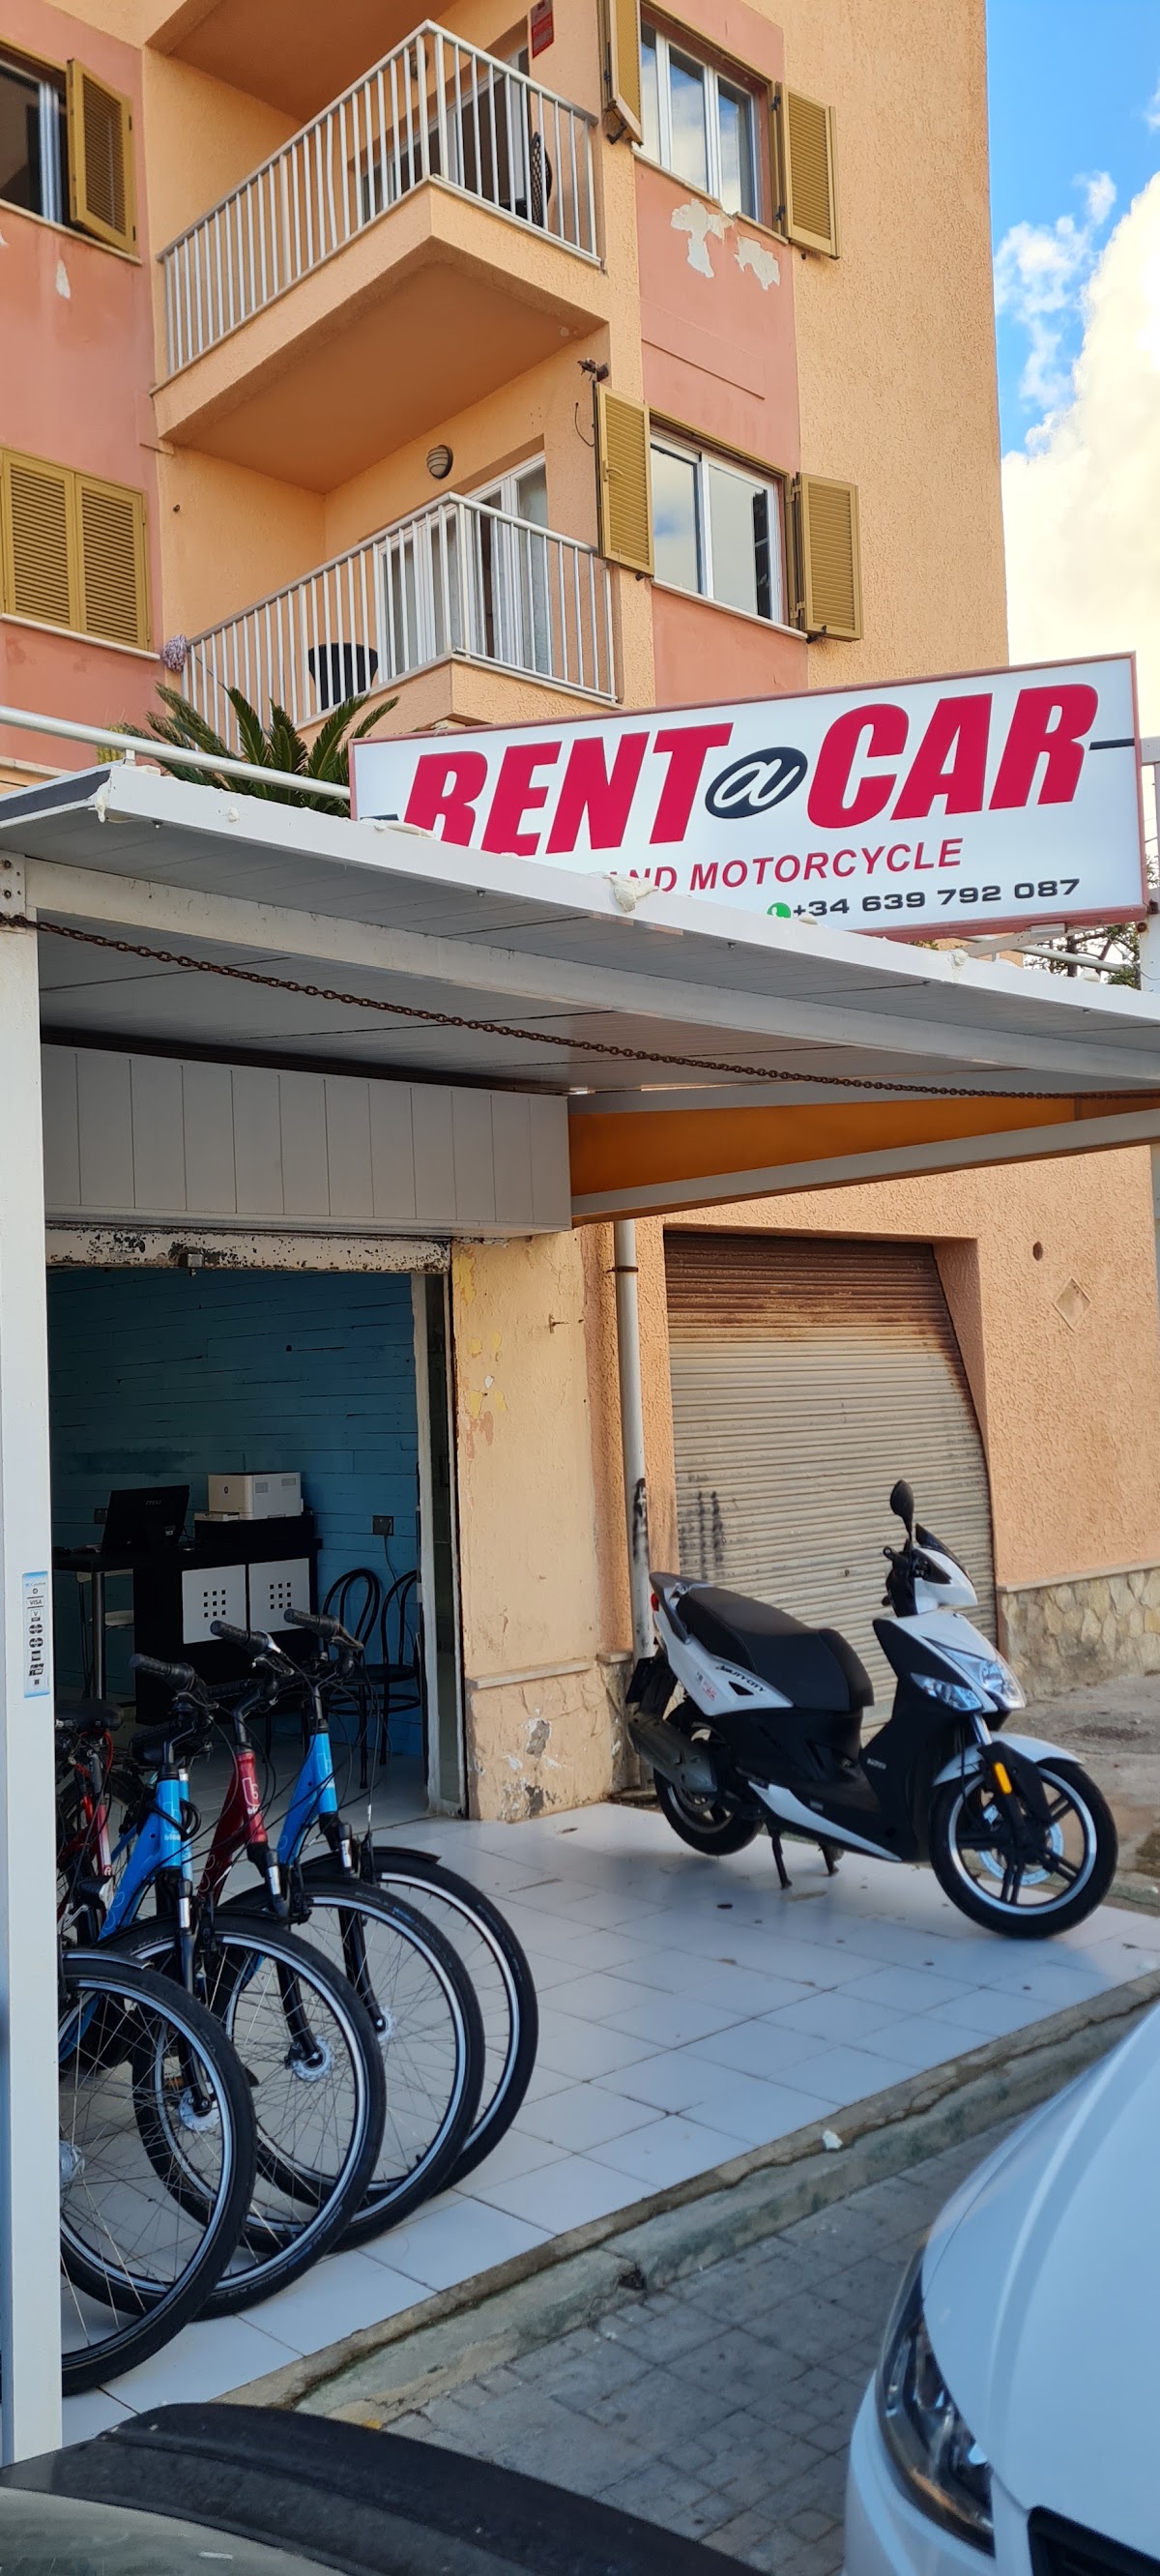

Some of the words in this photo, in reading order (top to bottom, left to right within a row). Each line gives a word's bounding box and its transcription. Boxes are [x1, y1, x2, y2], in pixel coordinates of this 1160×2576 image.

[689, 837, 963, 892] MOTORCYCLE
[793, 897, 850, 918] +34
[862, 891, 925, 912] 639
[938, 885, 1001, 907] 792
[1014, 878, 1081, 900] 087
